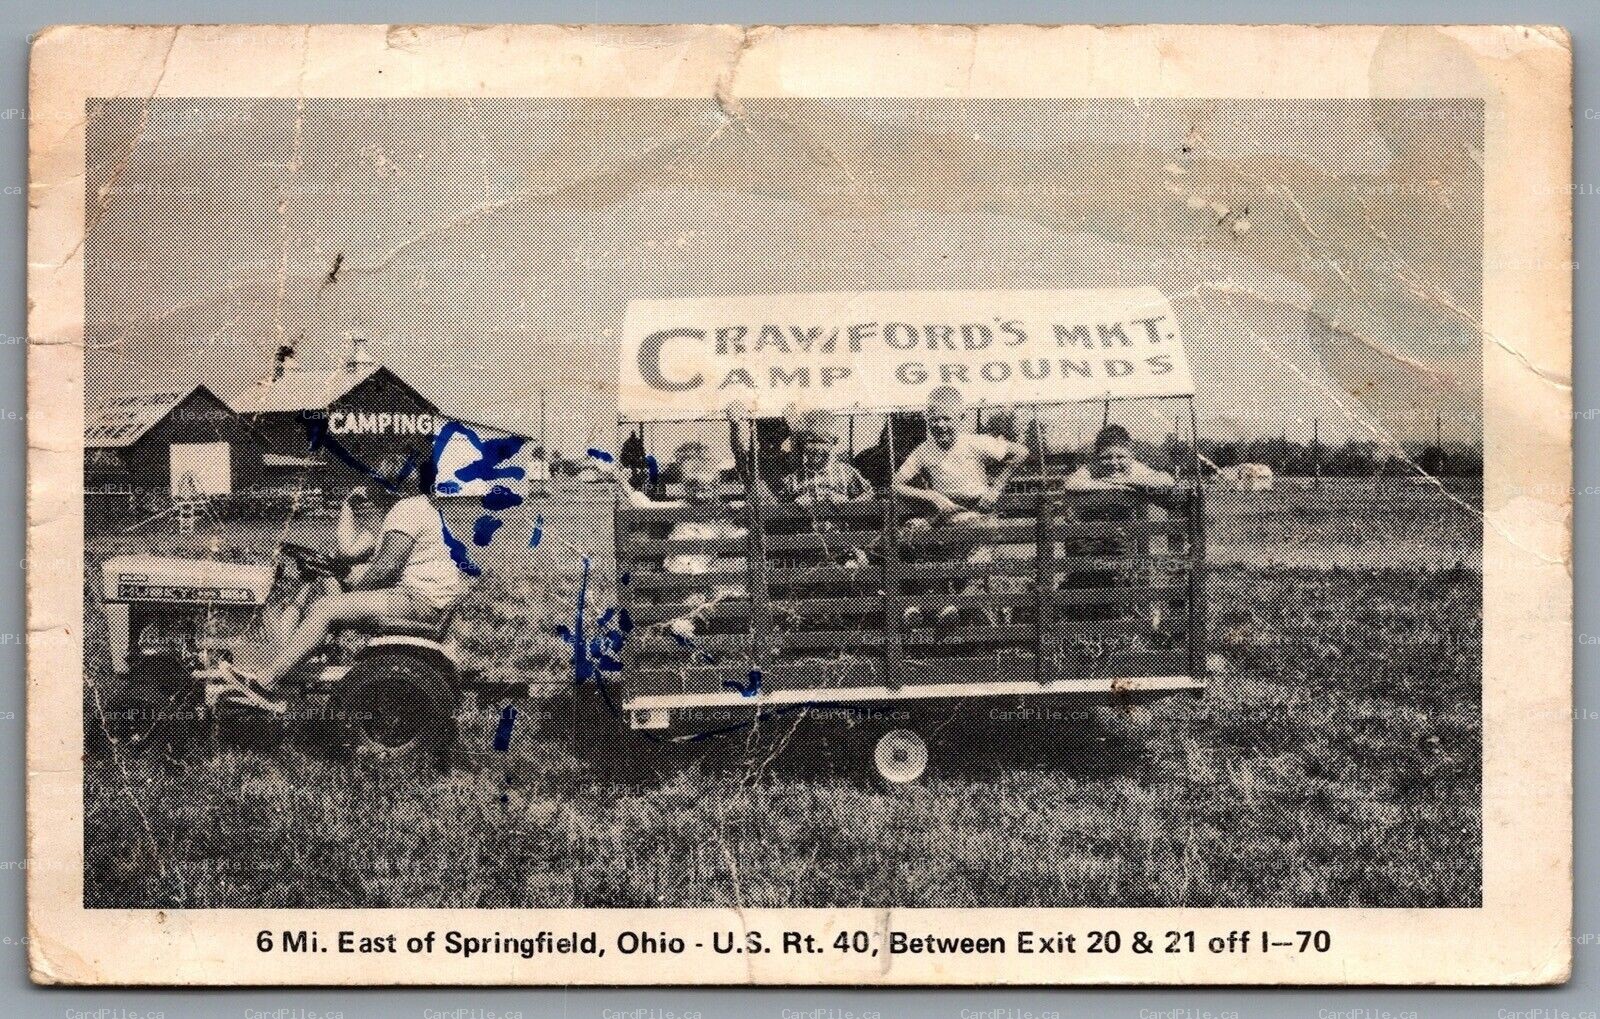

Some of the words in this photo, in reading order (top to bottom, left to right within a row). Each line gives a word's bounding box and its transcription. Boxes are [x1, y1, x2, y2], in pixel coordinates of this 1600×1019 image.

[1053, 316, 1174, 350] MKT.
[895, 354, 1173, 385] GROUNDS
[329, 412, 432, 435] CAMPING
[257, 931, 273, 952] 6
[283, 931, 327, 952] Mi.
[339, 932, 396, 953] East
[407, 932, 435, 953] of
[446, 932, 604, 958] Springfield,
[618, 932, 684, 953] Ohio
[714, 932, 770, 953] U.S.
[784, 932, 823, 953] Rt.
[834, 931, 878, 957] 40,
[890, 932, 1005, 953] Between
[1018, 931, 1075, 953] Exit
[1088, 931, 1120, 953] 20
[1132, 932, 1153, 953] &
[1165, 931, 1194, 952] 21
[1209, 931, 1250, 953] off
